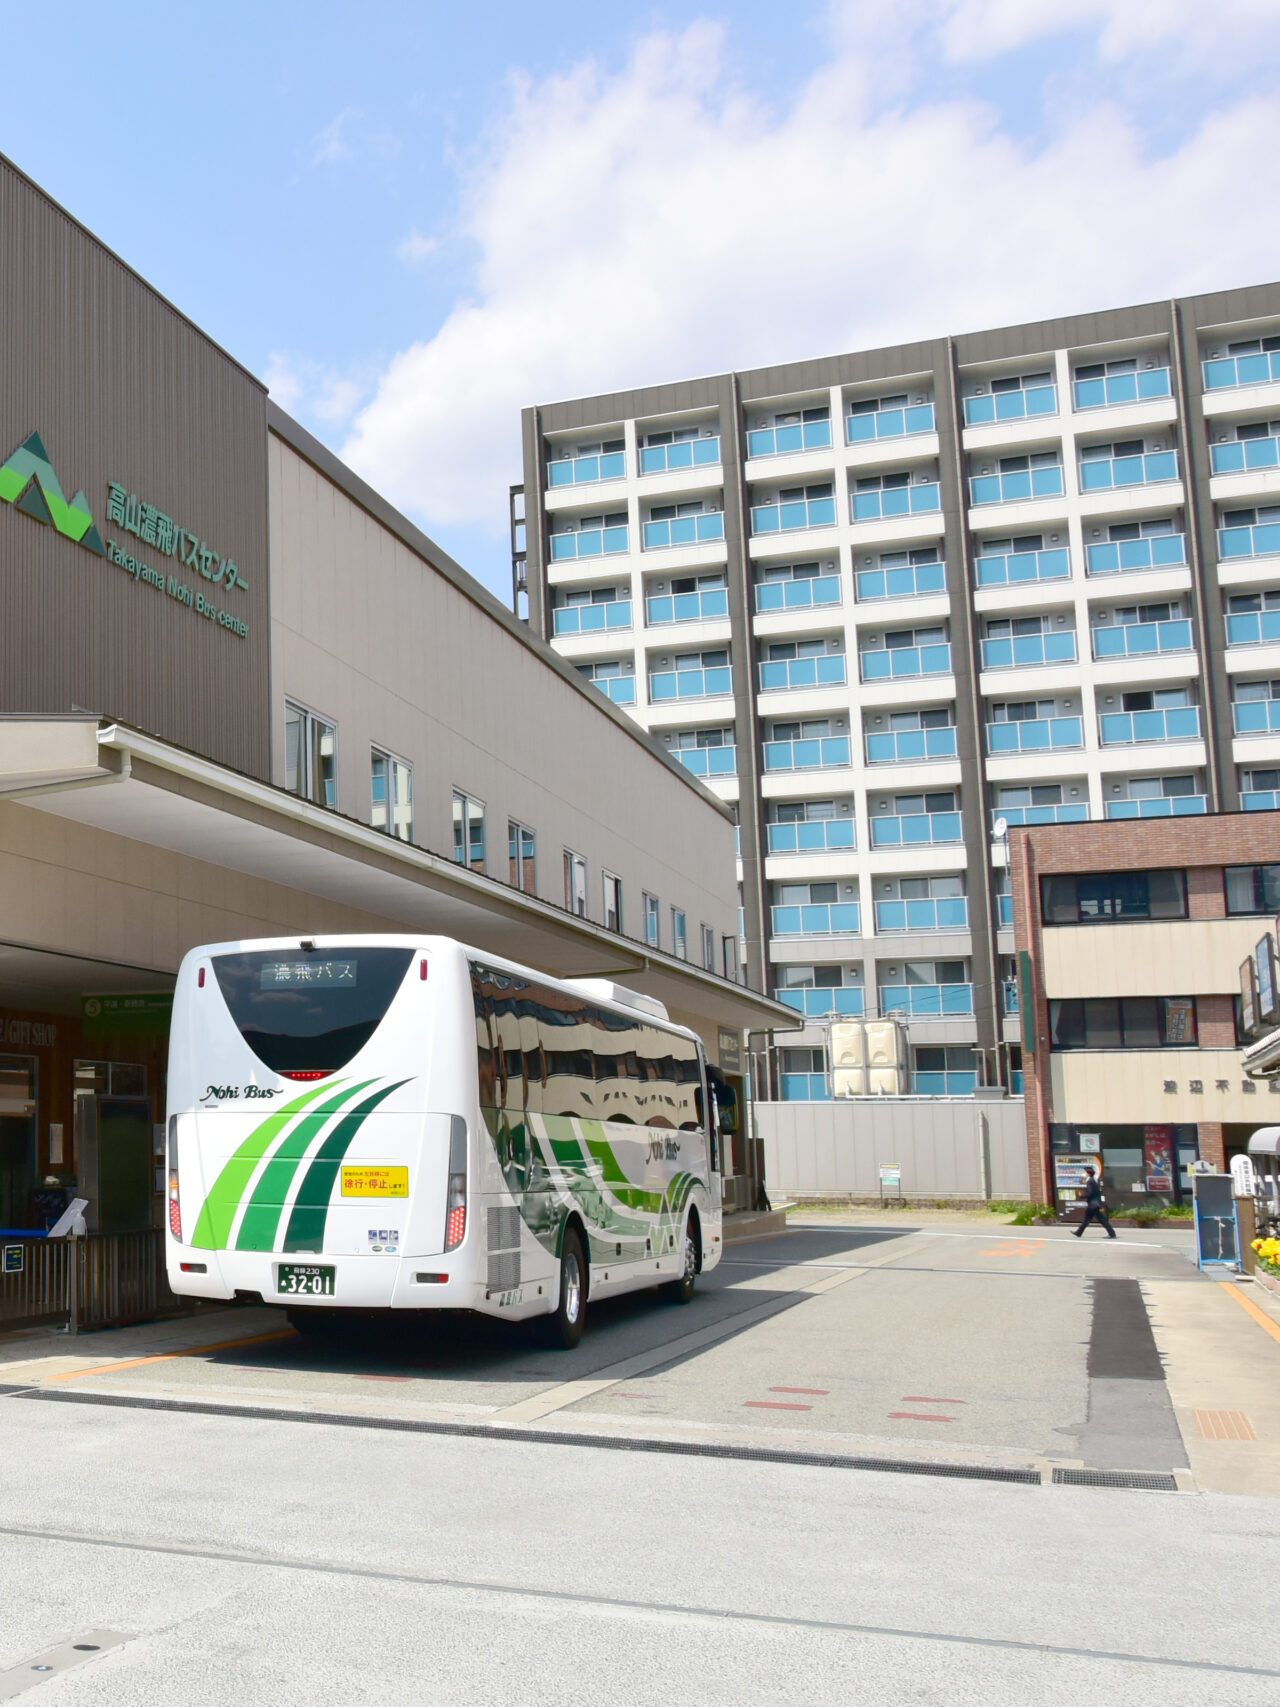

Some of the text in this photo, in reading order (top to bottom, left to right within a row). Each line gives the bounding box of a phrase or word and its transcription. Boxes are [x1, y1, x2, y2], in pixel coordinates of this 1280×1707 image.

[106, 481, 249, 591] 高山濃飛バスセンター
[106, 540, 250, 638] Takayama Nohi Bus center
[274, 962, 354, 982] 濃飛バス
[200, 1085, 283, 1101] Nohi Bus
